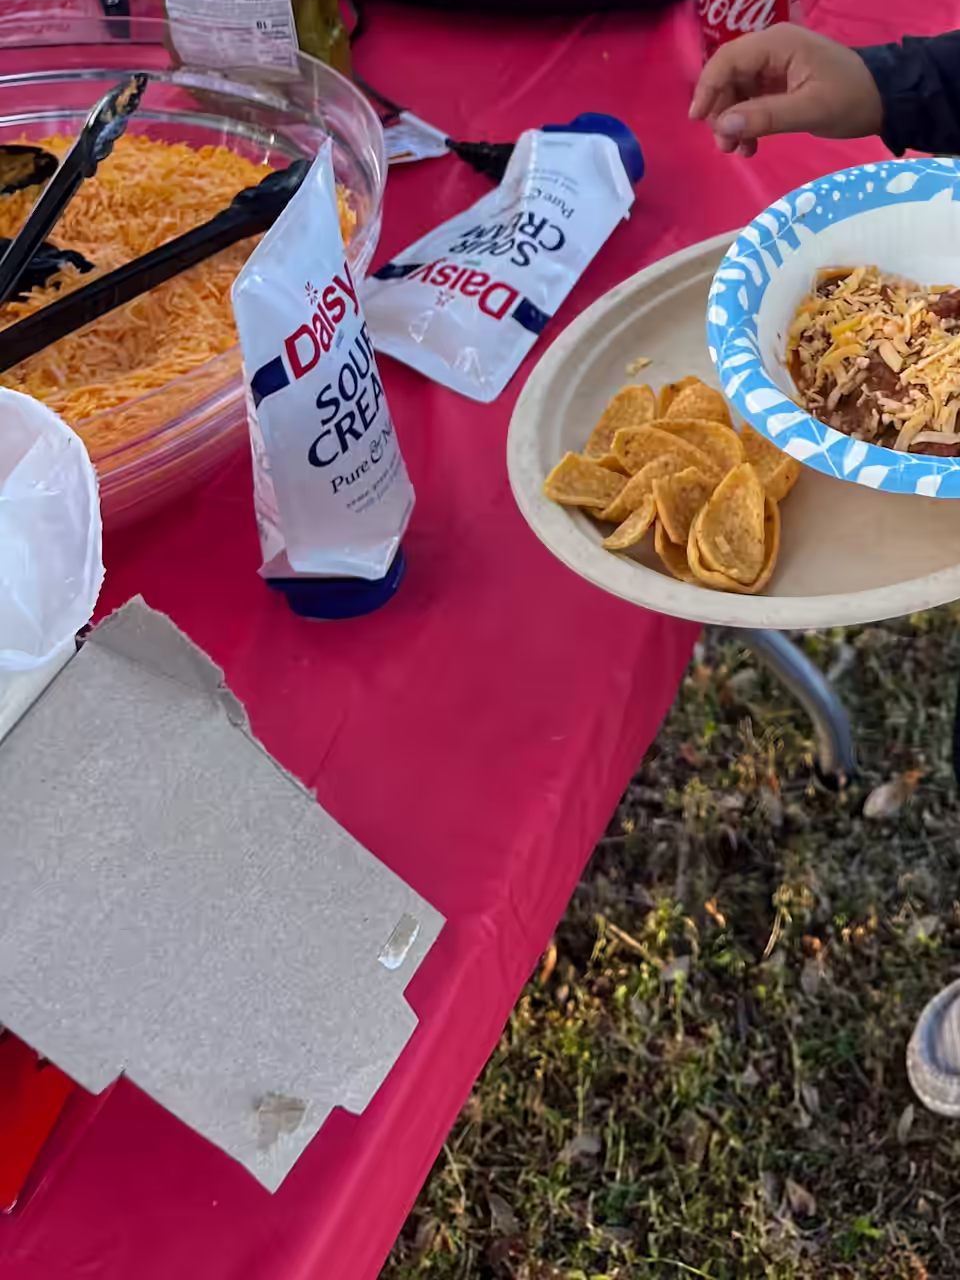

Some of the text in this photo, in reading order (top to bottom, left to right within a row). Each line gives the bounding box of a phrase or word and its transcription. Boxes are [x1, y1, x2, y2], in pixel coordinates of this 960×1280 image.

[284, 260, 359, 380] Daisy
[409, 257, 520, 321] Daisy
[330, 460, 370, 494] Pure
